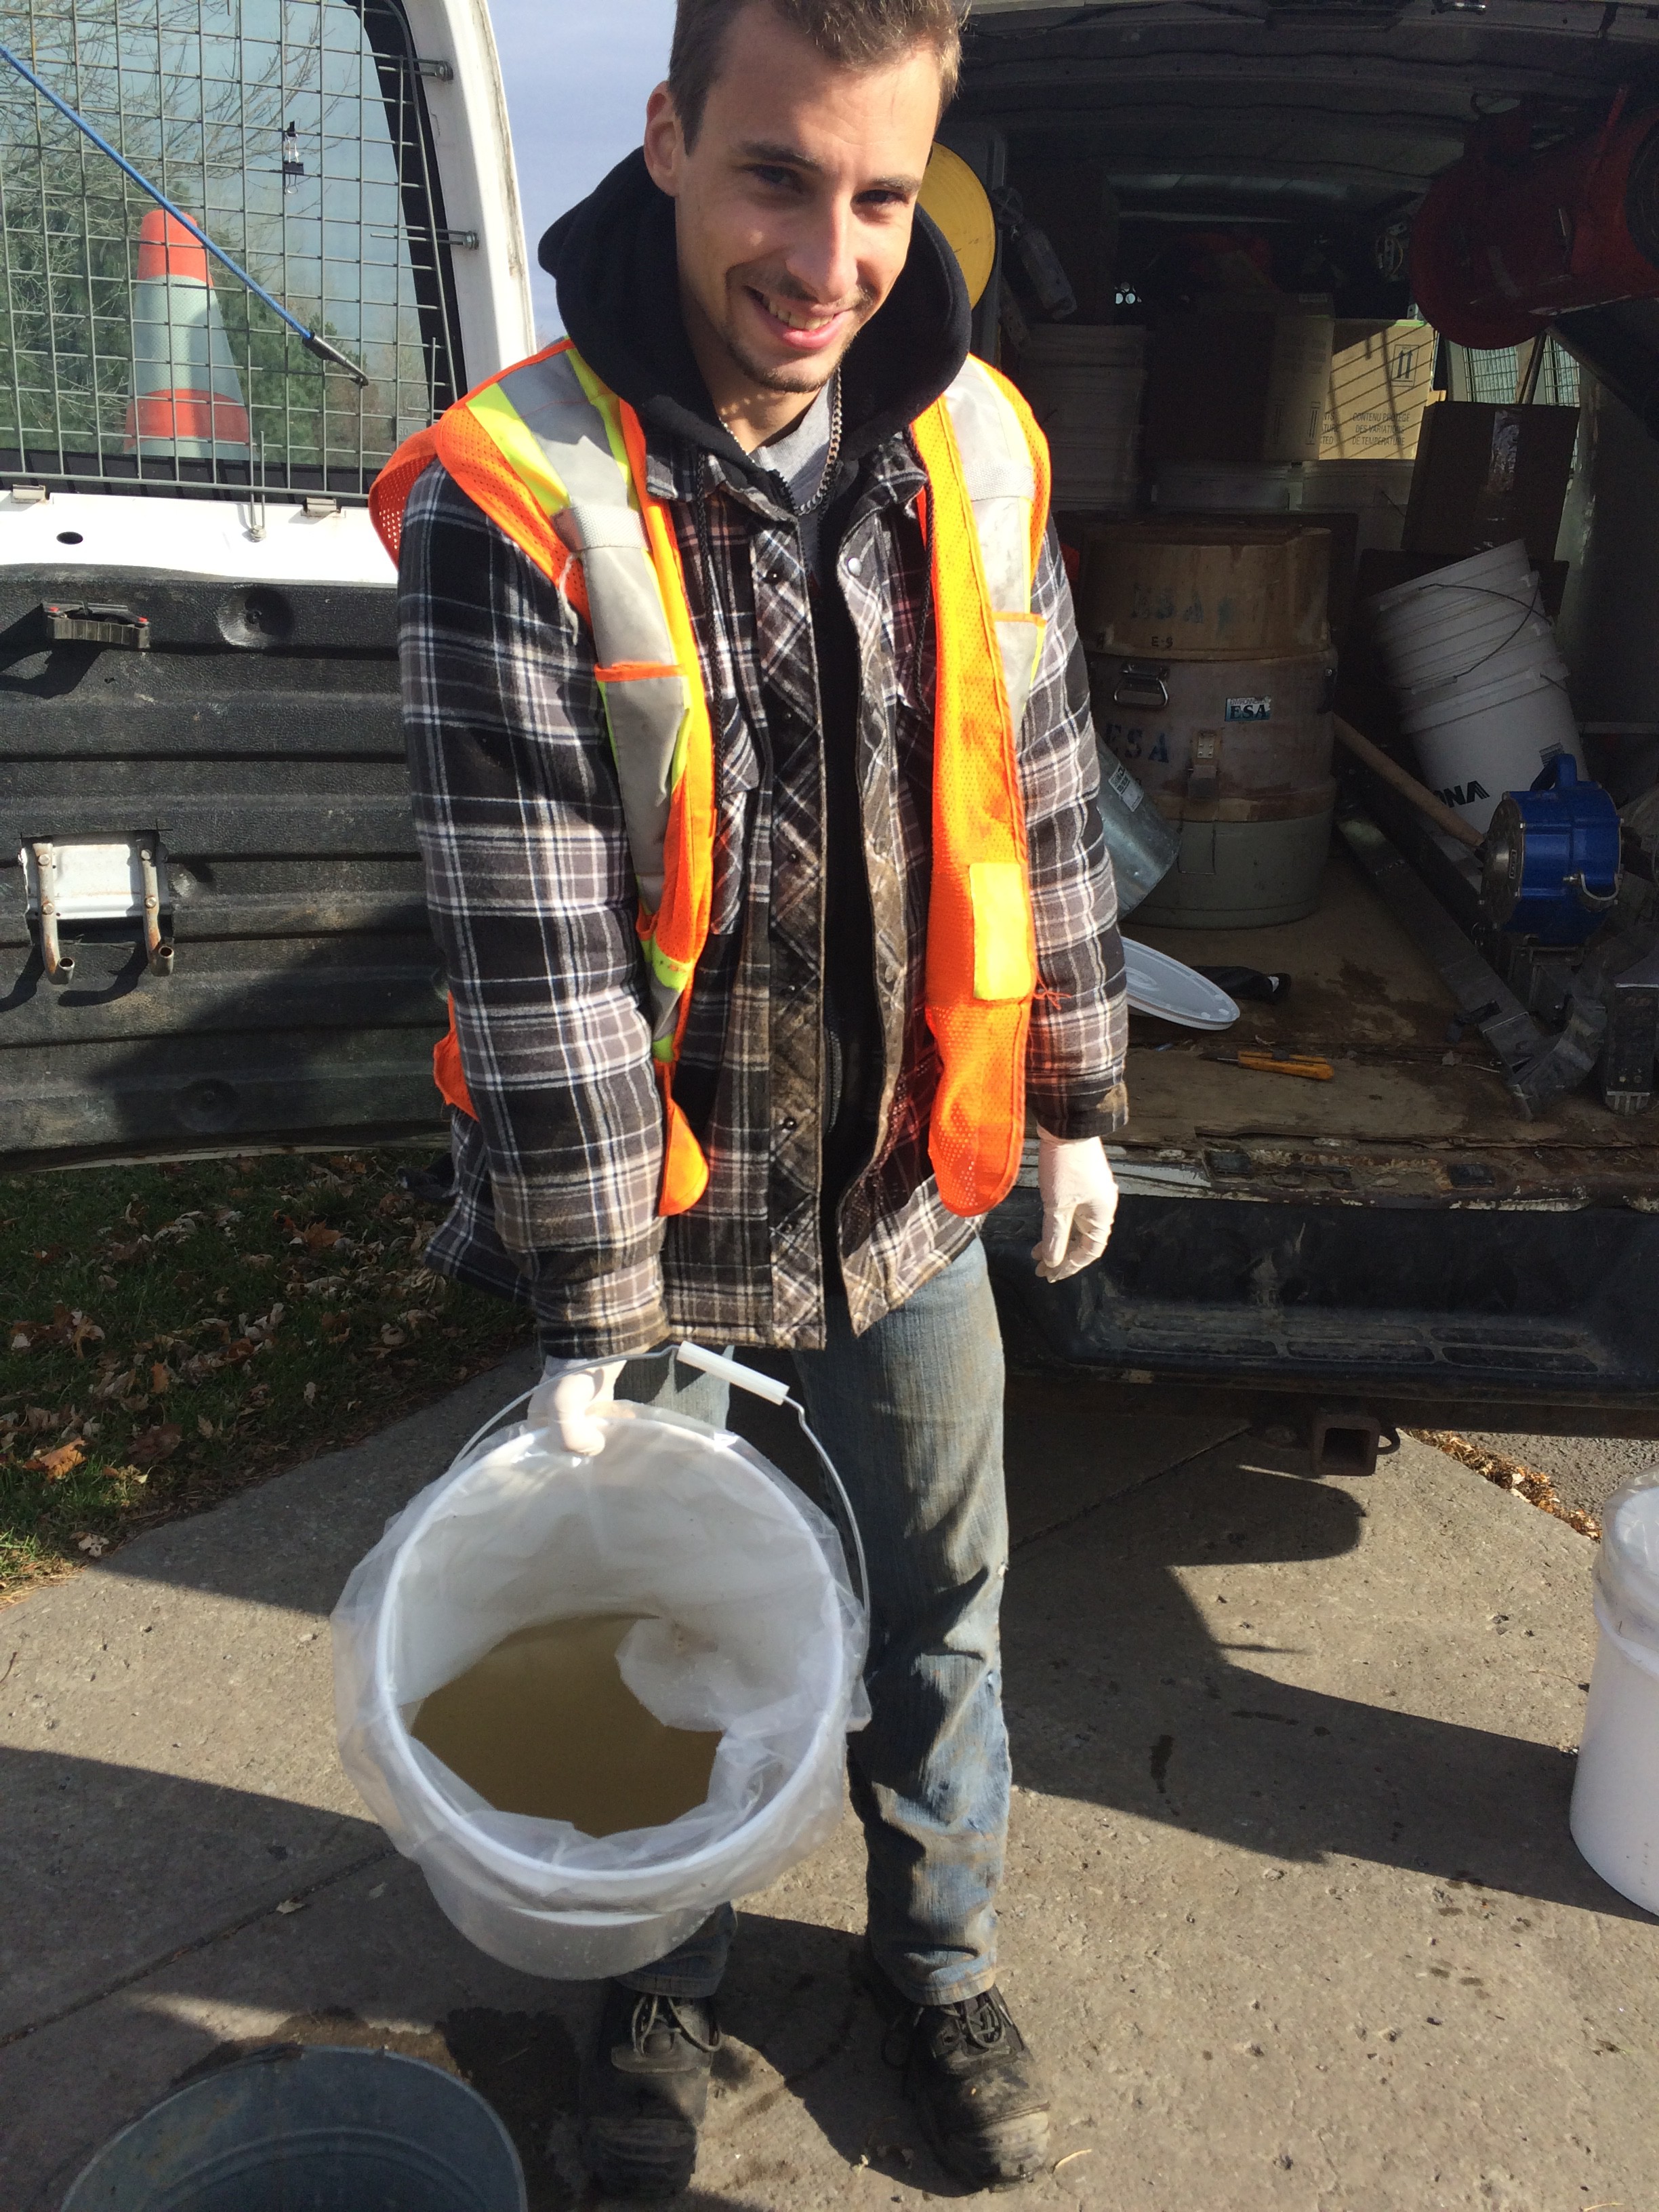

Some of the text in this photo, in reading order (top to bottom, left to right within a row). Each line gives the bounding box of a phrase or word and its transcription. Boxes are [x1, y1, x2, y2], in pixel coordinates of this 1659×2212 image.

[1353, 412, 1381, 422] CONTENU
[1355, 424, 1405, 434] DES VARIATIONS
[1352, 436, 1360, 445] DE
[1230, 704, 1266, 719] ESA
[1105, 722, 1169, 763] ESA
